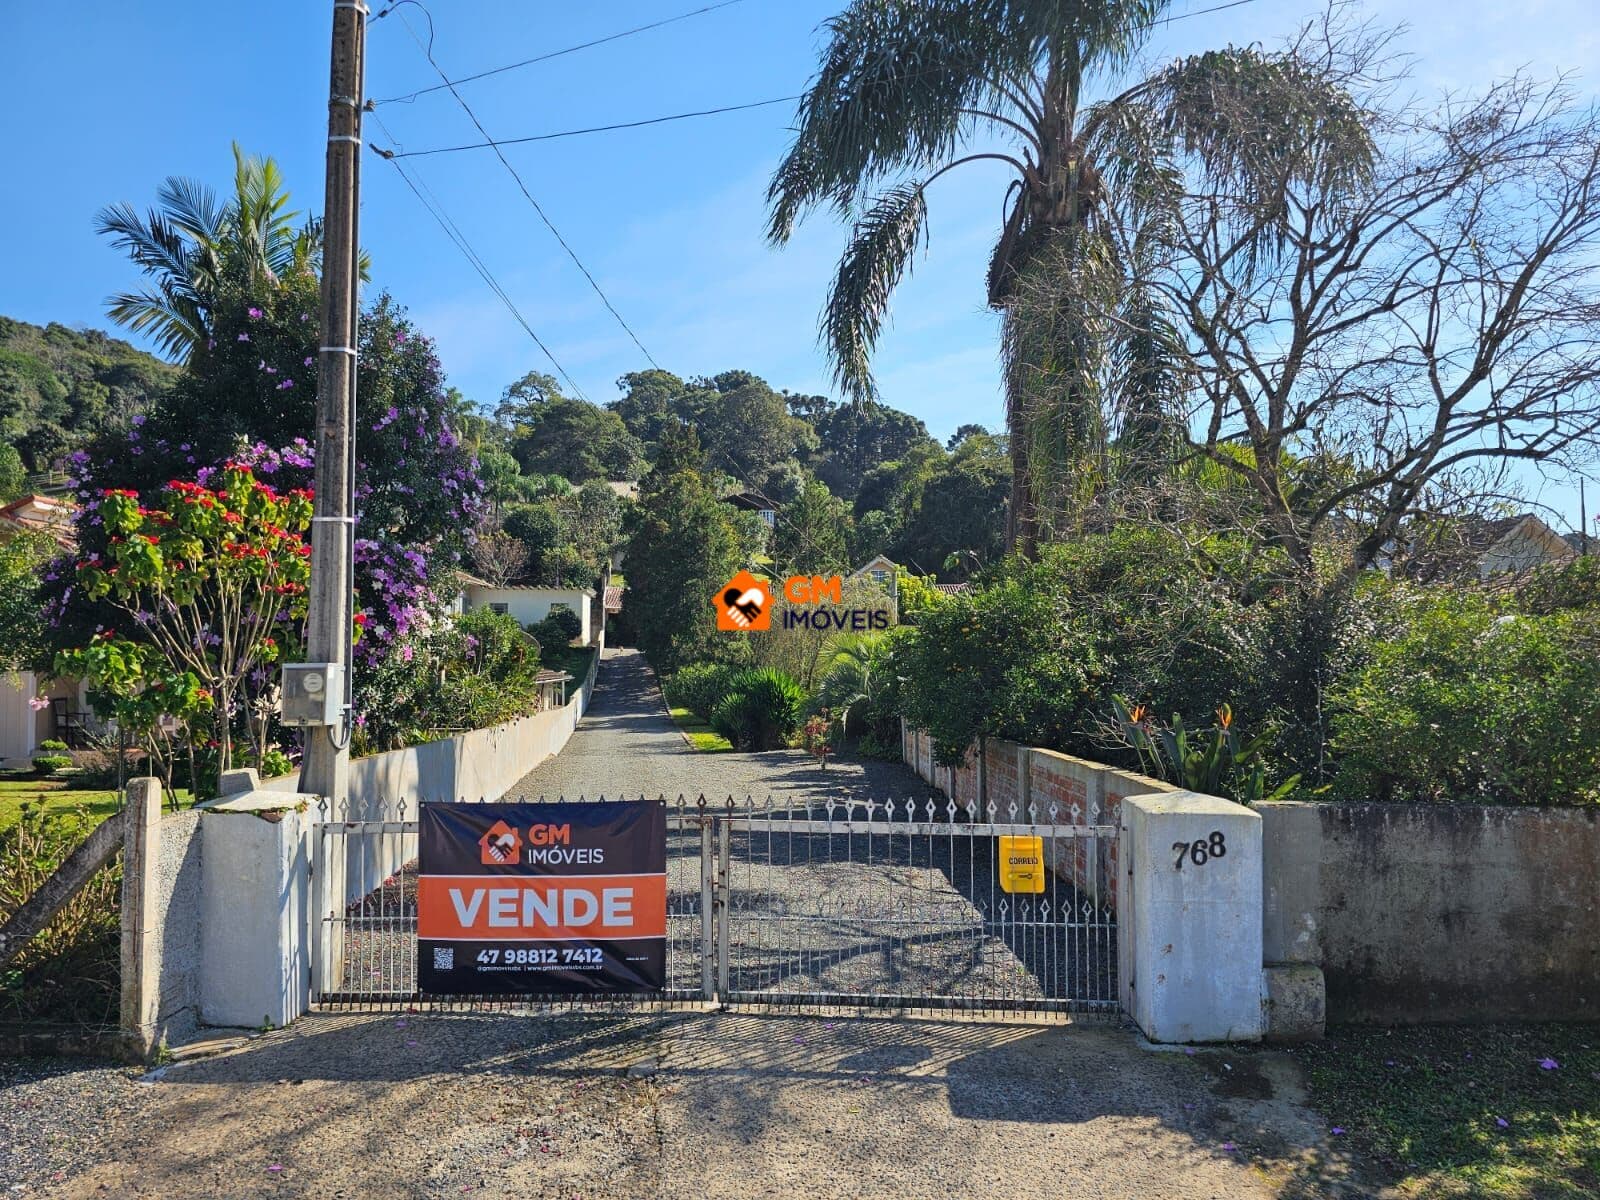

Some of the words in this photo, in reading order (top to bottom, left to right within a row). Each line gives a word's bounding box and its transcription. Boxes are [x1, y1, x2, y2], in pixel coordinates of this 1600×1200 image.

[528, 824, 570, 846] GM
[528, 845, 604, 865] IMÓVEIS
[1008, 856, 1039, 865] CORREIO
[1172, 831, 1226, 869] 768
[448, 887, 634, 928] VENDE
[476, 949, 500, 964] 47
[504, 949, 558, 964] 98812
[562, 948, 603, 963] 7412
